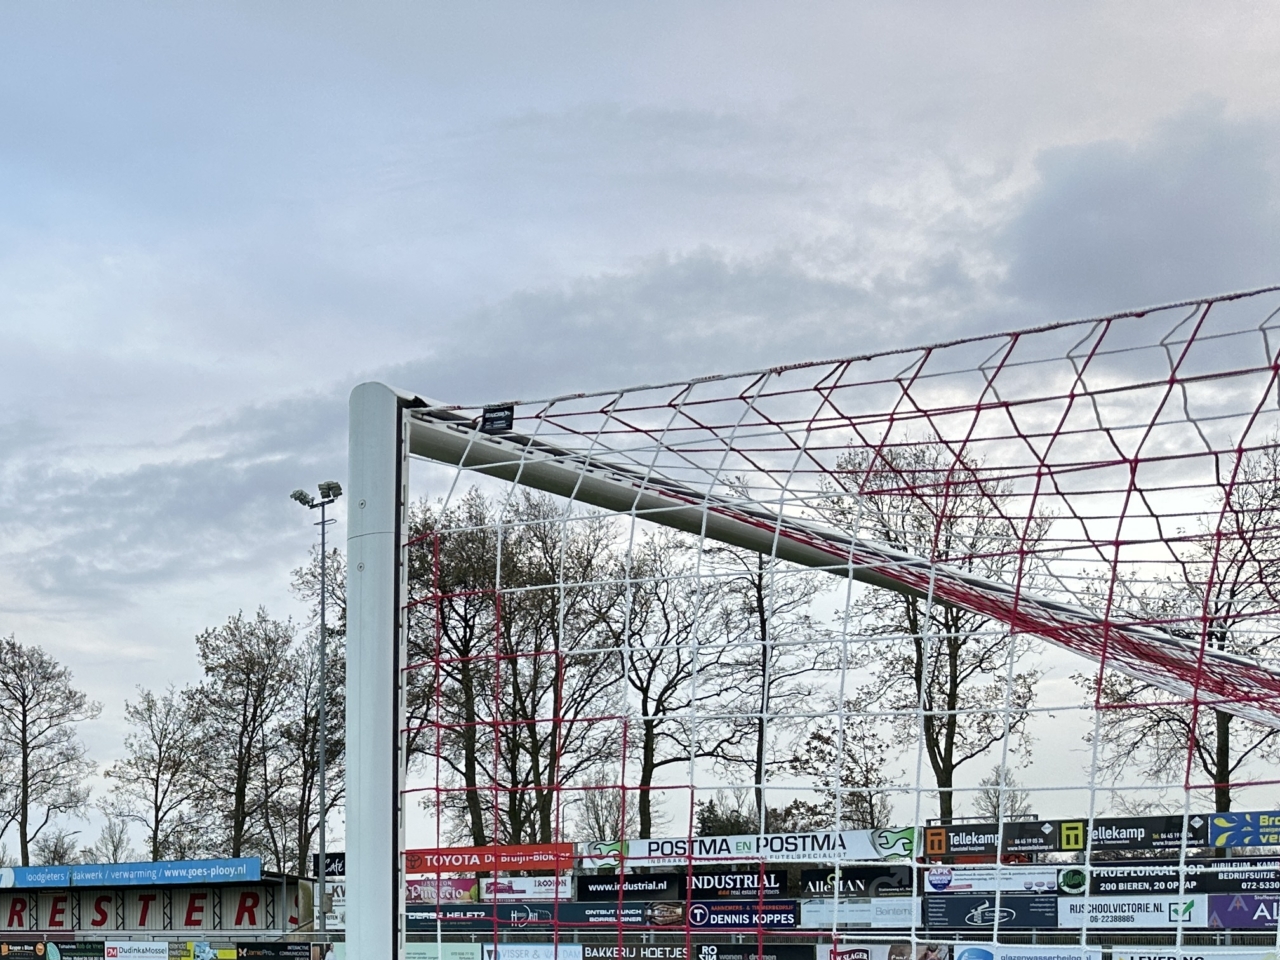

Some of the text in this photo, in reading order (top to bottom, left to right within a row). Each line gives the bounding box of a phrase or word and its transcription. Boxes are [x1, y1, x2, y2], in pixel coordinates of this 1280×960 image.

[735, 841, 751, 851] EN
[756, 833, 847, 853] POSTMA
[948, 832, 1000, 846] Tellekamp
[424, 854, 481, 867] TOYOTA
[26, 870, 65, 883] loodgieters
[72, 871, 103, 880] dakwerk
[110, 868, 157, 880] verwarming
[164, 864, 246, 879] www.goes-plooy.nl
[1218, 871, 1276, 880] BEDRIJFSUITJE
[588, 881, 667, 891] www.industrial.nl
[685, 874, 780, 889] INDUSTRIAL
[1100, 882, 1117, 891] 200
[1118, 882, 1152, 891] BIEREN,
[1153, 881, 1165, 890] 20
[1167, 881, 1179, 889] OP
[446, 911, 485, 920] HELFT?
[710, 913, 795, 924] DENNIS KOPPES
[501, 949, 530, 959] VISSER
[584, 947, 636, 958] BAKKERIJ
[842, 951, 869, 960] SLAGER
